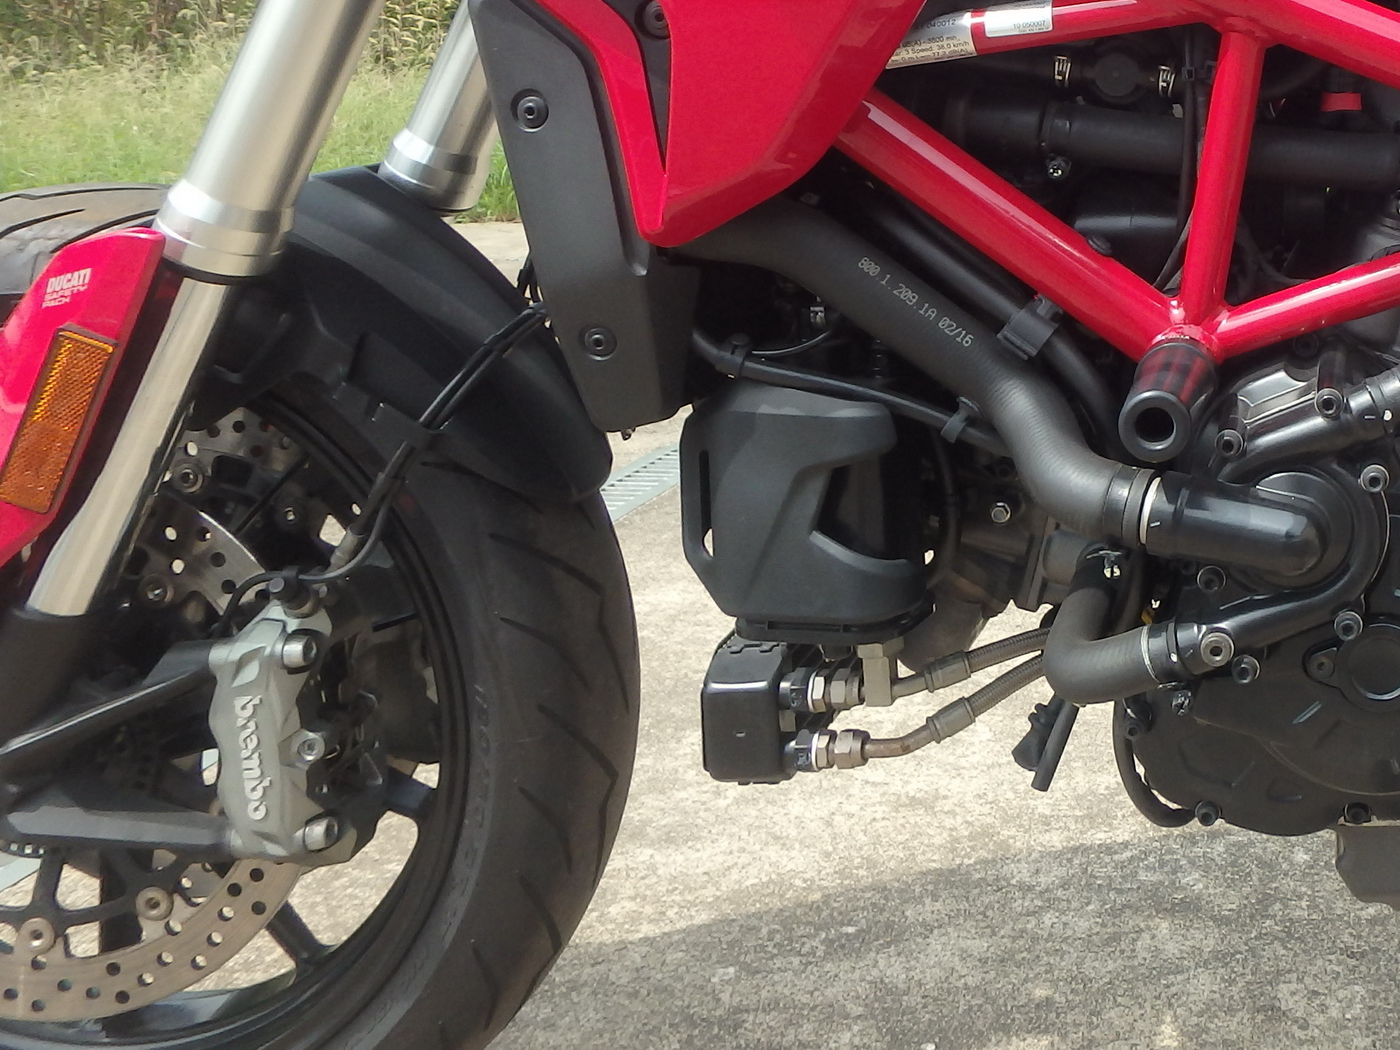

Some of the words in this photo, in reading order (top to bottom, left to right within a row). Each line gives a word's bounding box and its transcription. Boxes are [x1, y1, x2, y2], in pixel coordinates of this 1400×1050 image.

[44, 284, 88, 301] SAFETY
[46, 268, 92, 293] DUCATI
[938, 316, 974, 347] 02/16
[234, 695, 271, 820] brembo
